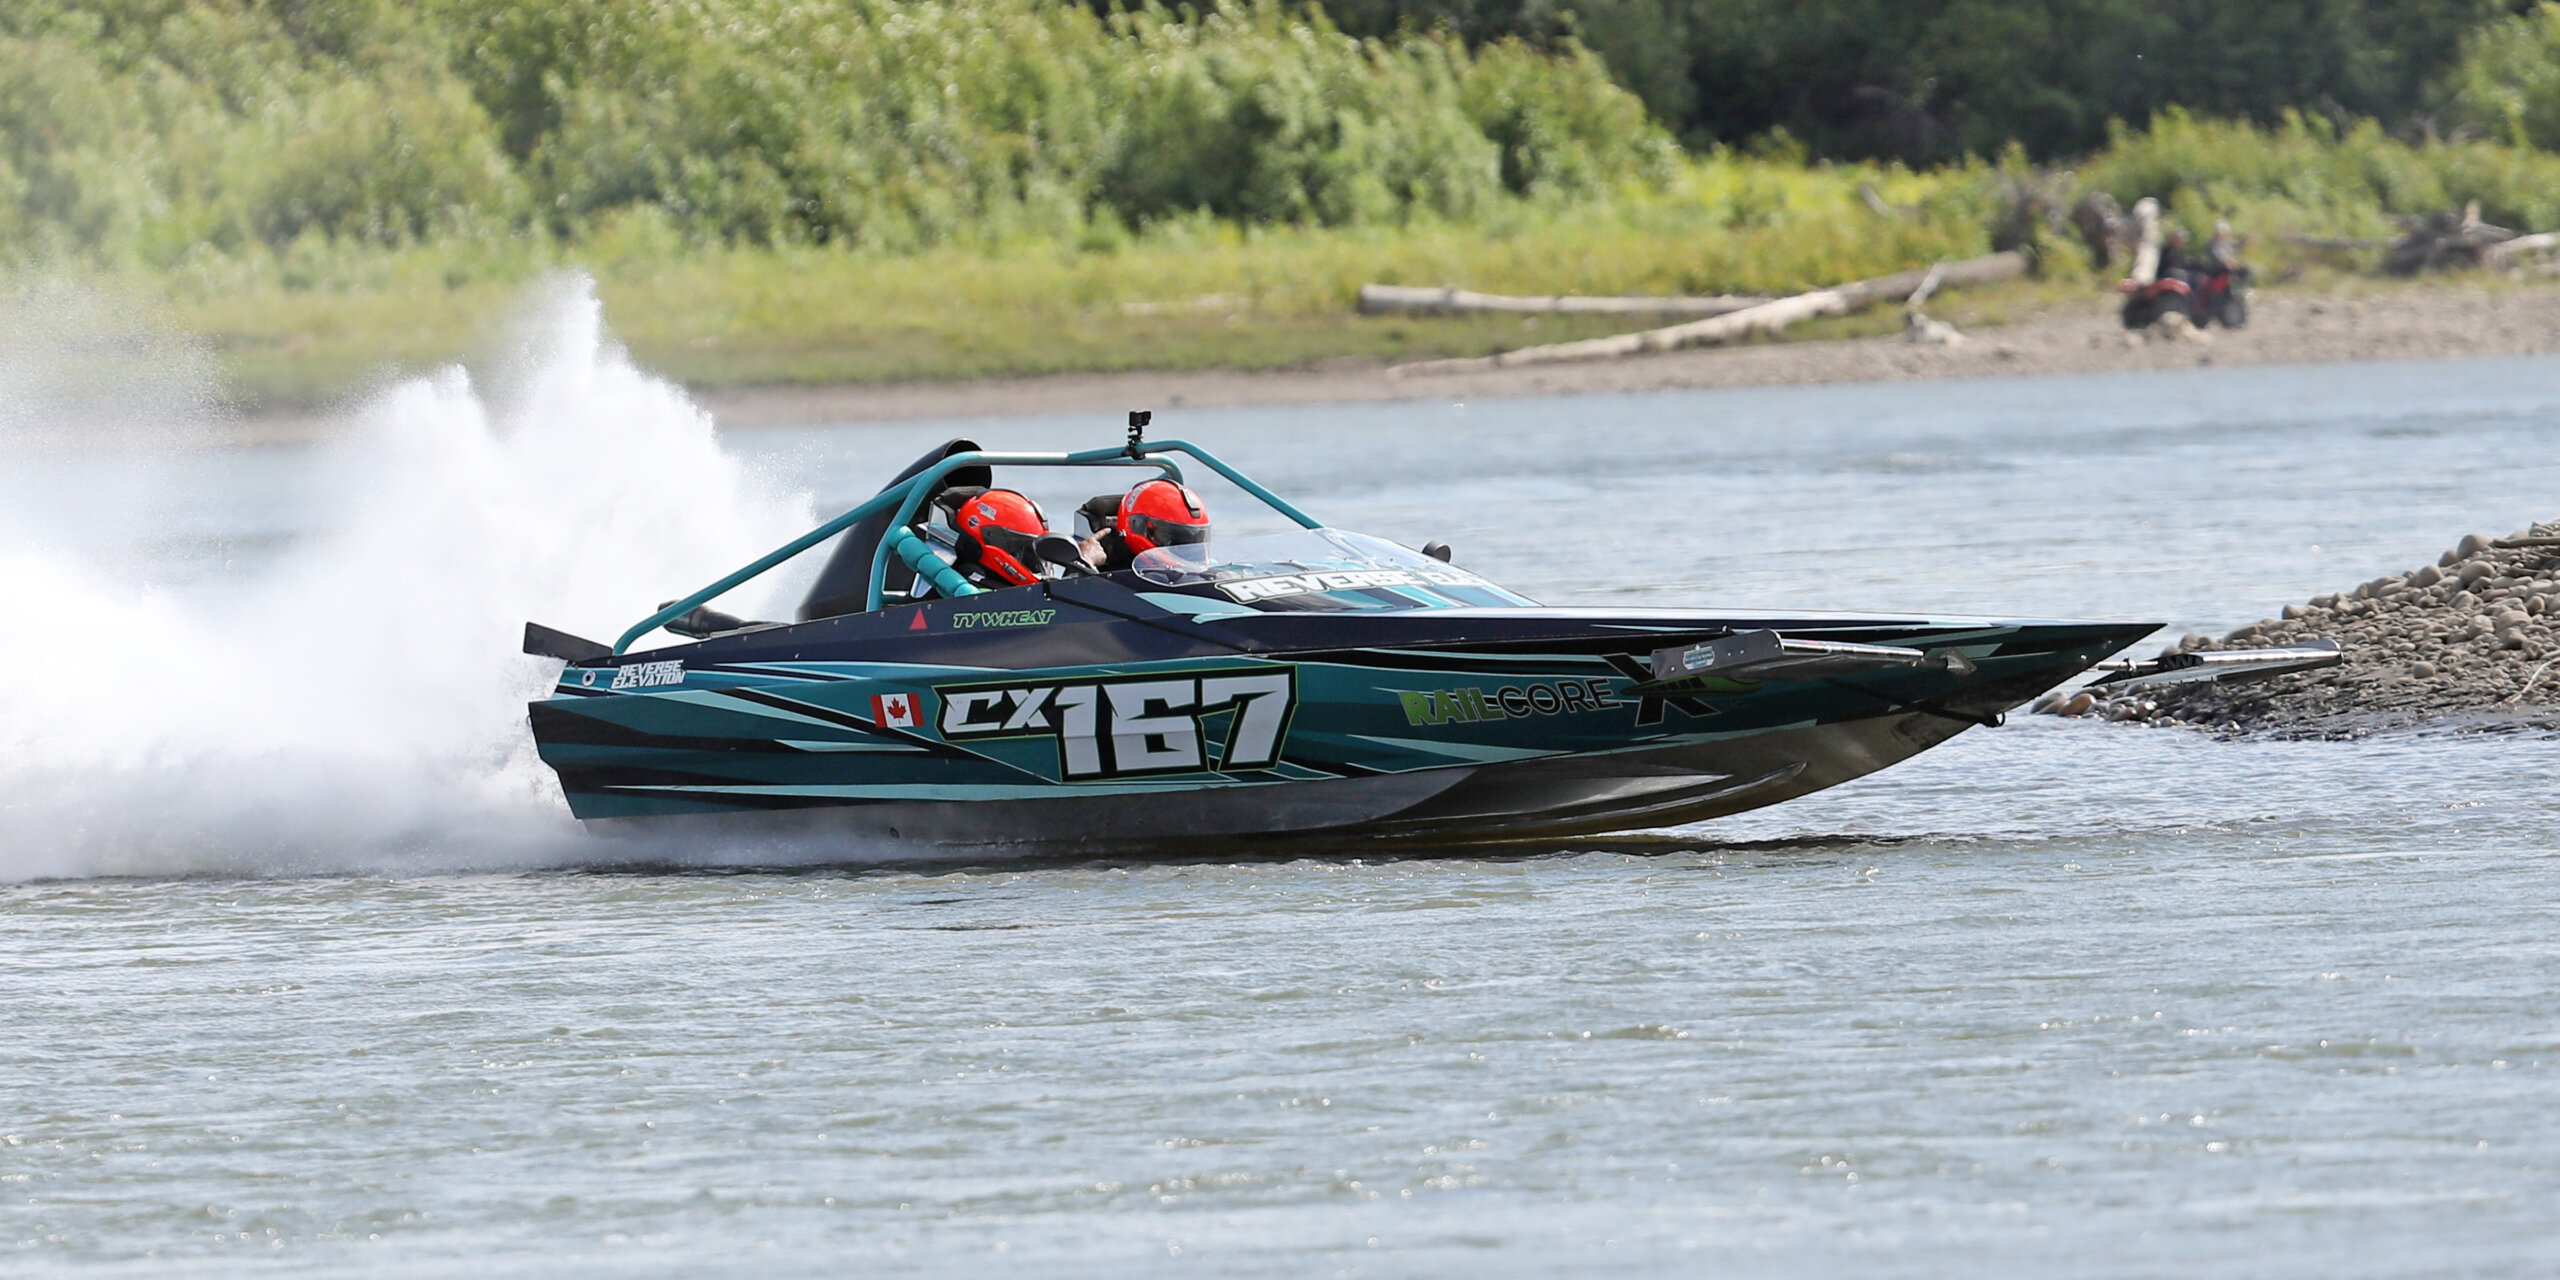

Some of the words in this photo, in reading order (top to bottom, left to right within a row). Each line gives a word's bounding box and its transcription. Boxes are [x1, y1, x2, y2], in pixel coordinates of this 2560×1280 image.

[1223, 571, 1426, 601] REVERSE
[953, 612, 981, 628] TY
[981, 609, 1056, 627] WHEAT
[617, 659, 684, 678] REVERSE
[610, 669, 688, 690] ELEVATION
[1397, 677, 1624, 727] RAILCORE
